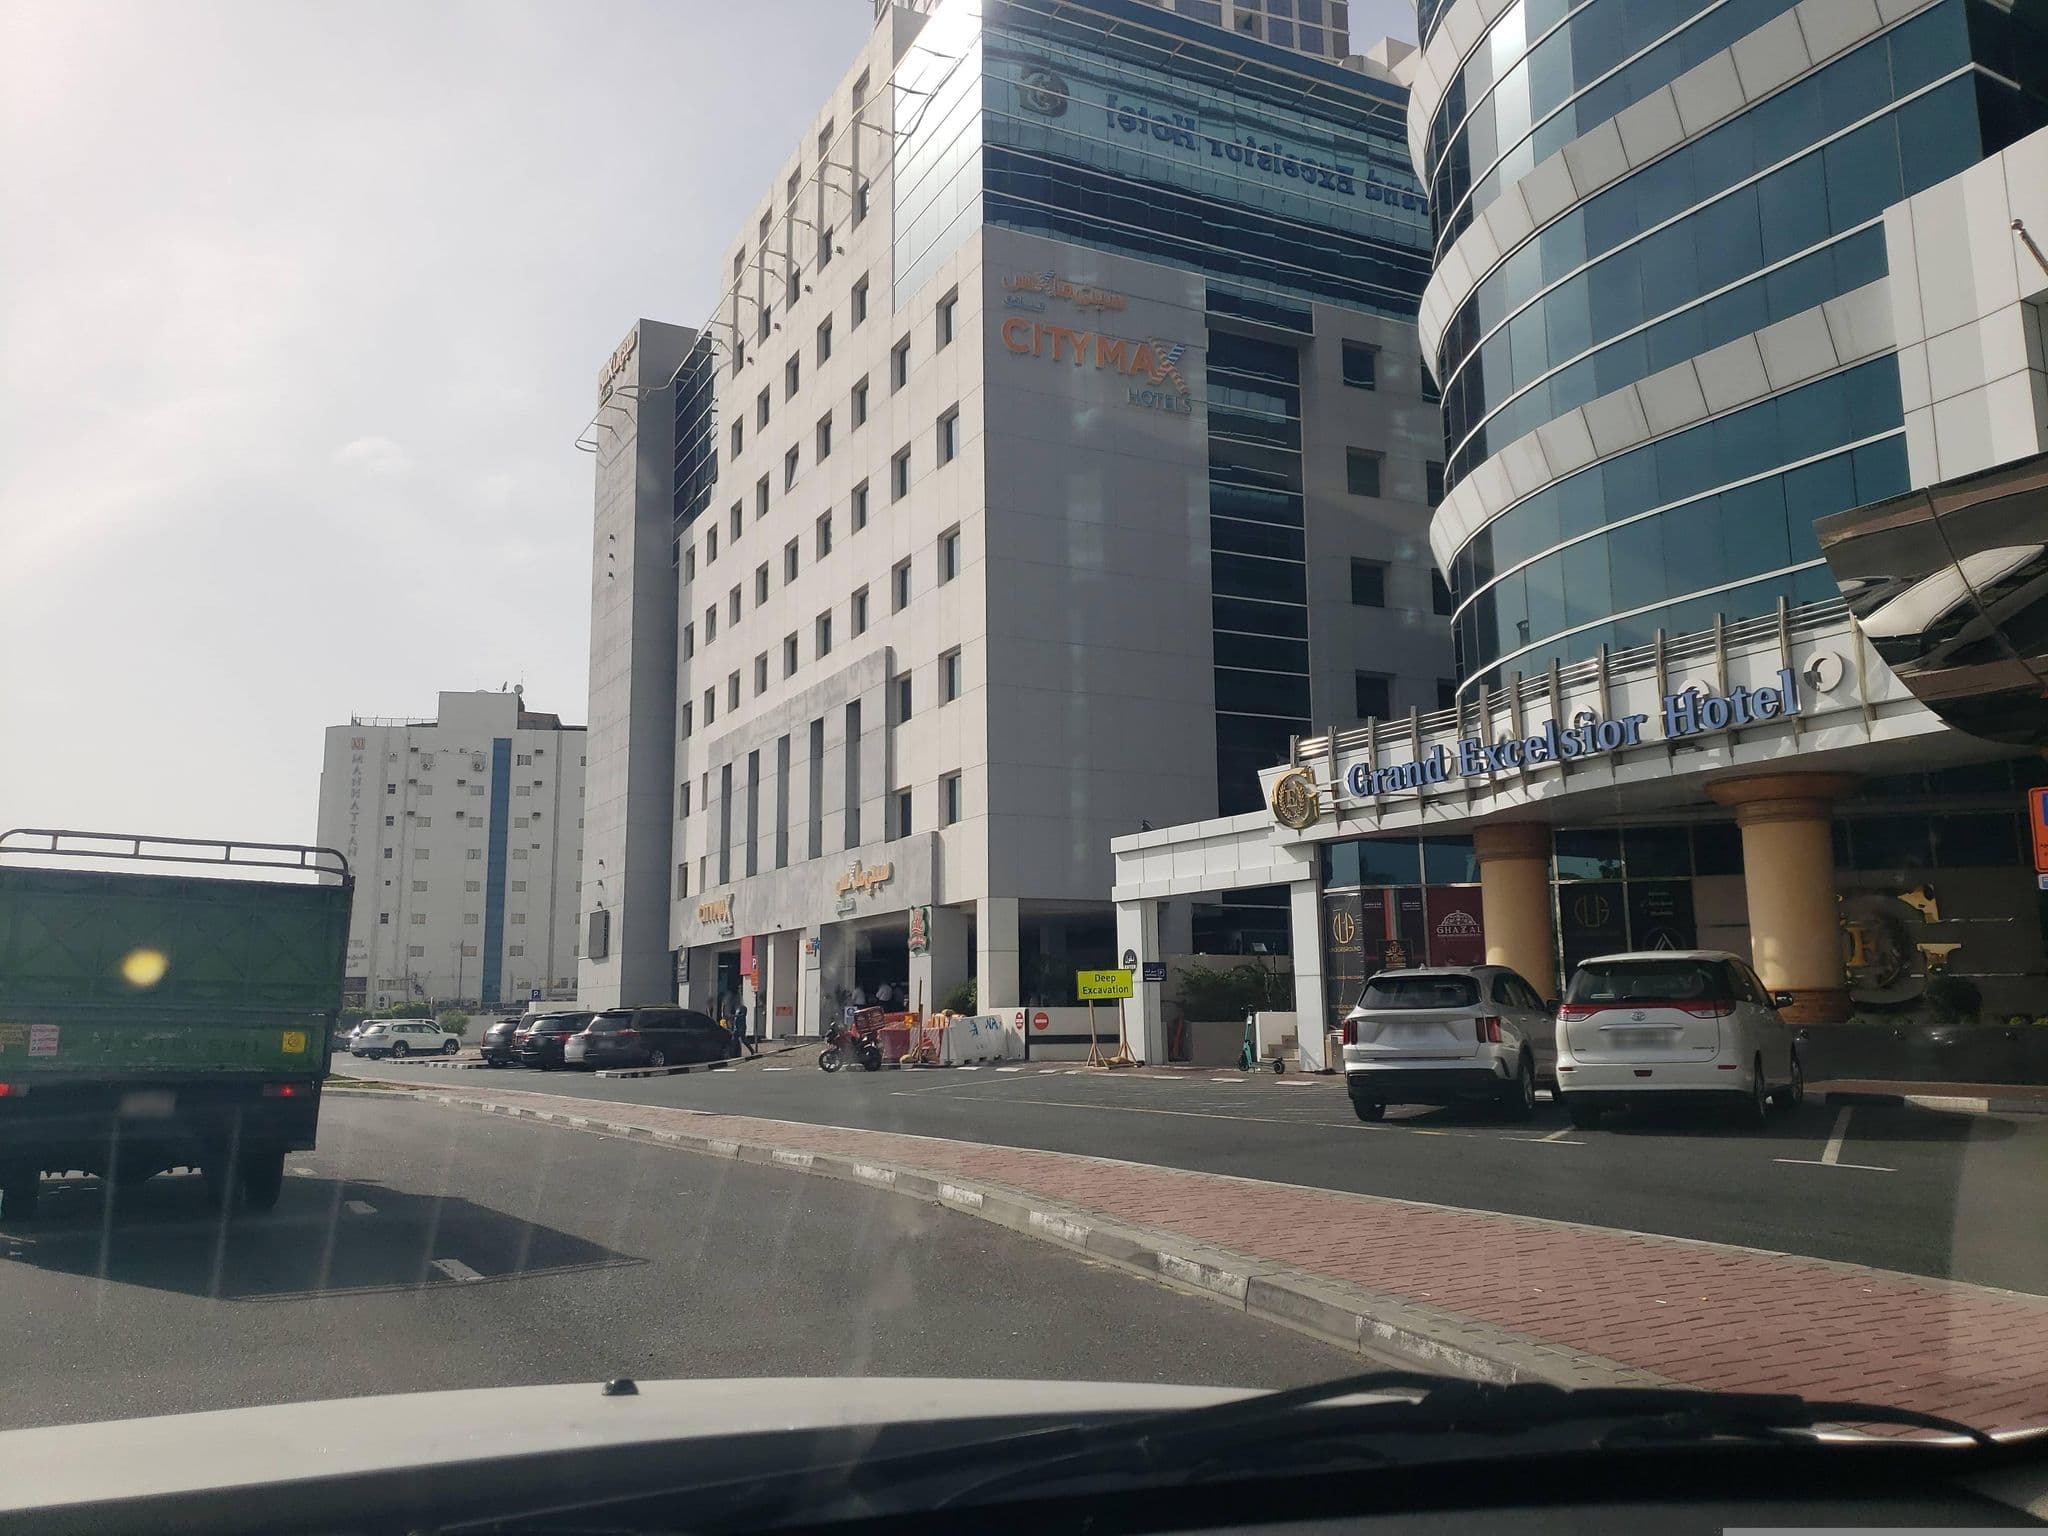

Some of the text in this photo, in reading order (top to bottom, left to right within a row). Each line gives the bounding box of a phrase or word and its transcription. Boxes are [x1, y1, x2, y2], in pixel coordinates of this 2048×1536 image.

[1001, 316, 1192, 397] CITYMAX
[1347, 668, 1801, 798] Grand Excelsior Hotel
[1436, 925, 1483, 935] GHAZAL
[752, 958, 757, 969] P
[1094, 973, 1117, 984] Deep
[533, 990, 539, 998] P
[1082, 984, 1129, 995] Excavation
